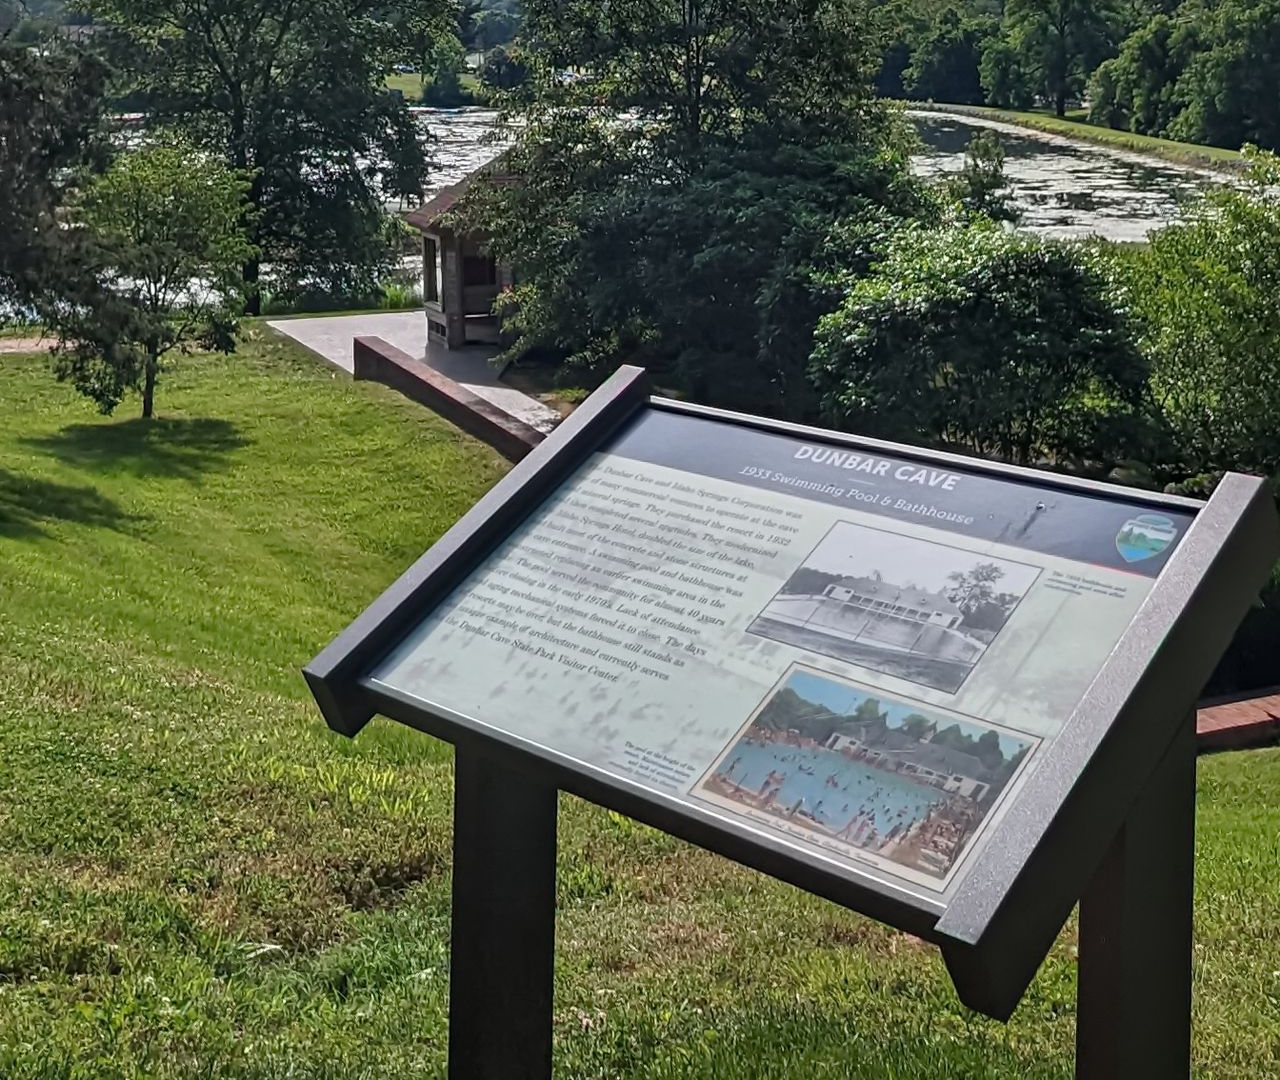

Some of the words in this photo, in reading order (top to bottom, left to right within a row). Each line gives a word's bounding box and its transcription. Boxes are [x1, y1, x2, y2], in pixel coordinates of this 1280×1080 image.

[603, 466, 634, 479] Dunbar
[633, 473, 654, 483] Cave
[653, 480, 672, 488] and
[730, 497, 783, 515] Corporation
[785, 511, 803, 519] was
[795, 445, 890, 475] DUNBAR
[894, 465, 961, 490] CAVE
[738, 465, 772, 479] 1933
[771, 472, 844, 497] Swimming
[845, 488, 880, 503] Pool
[879, 495, 892, 506] &
[894, 498, 973, 524] Bathhouse
[637, 531, 673, 546] doubled
[671, 540, 687, 550] the
[705, 550, 720, 559] of
[717, 552, 734, 562] the
[644, 503, 666, 516] They
[664, 511, 711, 526] purchased
[709, 520, 726, 530] the
[753, 531, 765, 540] in
[766, 534, 792, 547] 1932
[701, 532, 725, 546] They
[761, 518, 778, 528] the
[586, 533, 600, 541] of
[596, 535, 611, 544] the
[610, 540, 647, 555] concrete
[646, 550, 667, 560] and
[663, 555, 689, 566] stone
[688, 562, 735, 579] structures
[735, 574, 749, 583] at
[636, 563, 661, 573] pool
[658, 569, 679, 579] and
[677, 573, 724, 592] bathhouse
[725, 586, 743, 598] was
[516, 557, 532, 568] The
[576, 576, 592, 585] the
[638, 594, 657, 604] for
[686, 608, 701, 618] 40
[696, 614, 726, 626] years
[546, 583, 562, 593] the
[561, 589, 584, 601] early
[615, 603, 639, 617] Lack
[639, 612, 654, 621] of
[650, 617, 700, 635] attendance
[601, 569, 631, 581] earlier
[631, 577, 676, 596] swimming
[675, 590, 697, 601] area
[697, 596, 709, 605] in
[709, 598, 726, 609] the
[467, 592, 496, 607] resorts
[496, 601, 516, 615] may
[510, 605, 526, 615] be
[545, 615, 563, 627] but
[561, 621, 577, 632] the
[577, 626, 622, 646] bathhouse
[623, 642, 644, 653] still
[642, 648, 673, 663] stands
[672, 658, 685, 667] as
[486, 582, 511, 595] aging
[588, 612, 619, 627] forced
[616, 622, 627, 631] it
[625, 624, 637, 634] to
[664, 635, 684, 648] The
[684, 641, 706, 656] days
[458, 621, 490, 637] Dunbar
[489, 631, 511, 644] Cave
[510, 639, 534, 653] State
[532, 646, 556, 661] Park
[557, 654, 587, 671] Visitor
[518, 625, 532, 633] of
[528, 629, 579, 650] architecture
[579, 646, 600, 657] and
[598, 652, 640, 671] currently
[639, 666, 670, 681] serves
